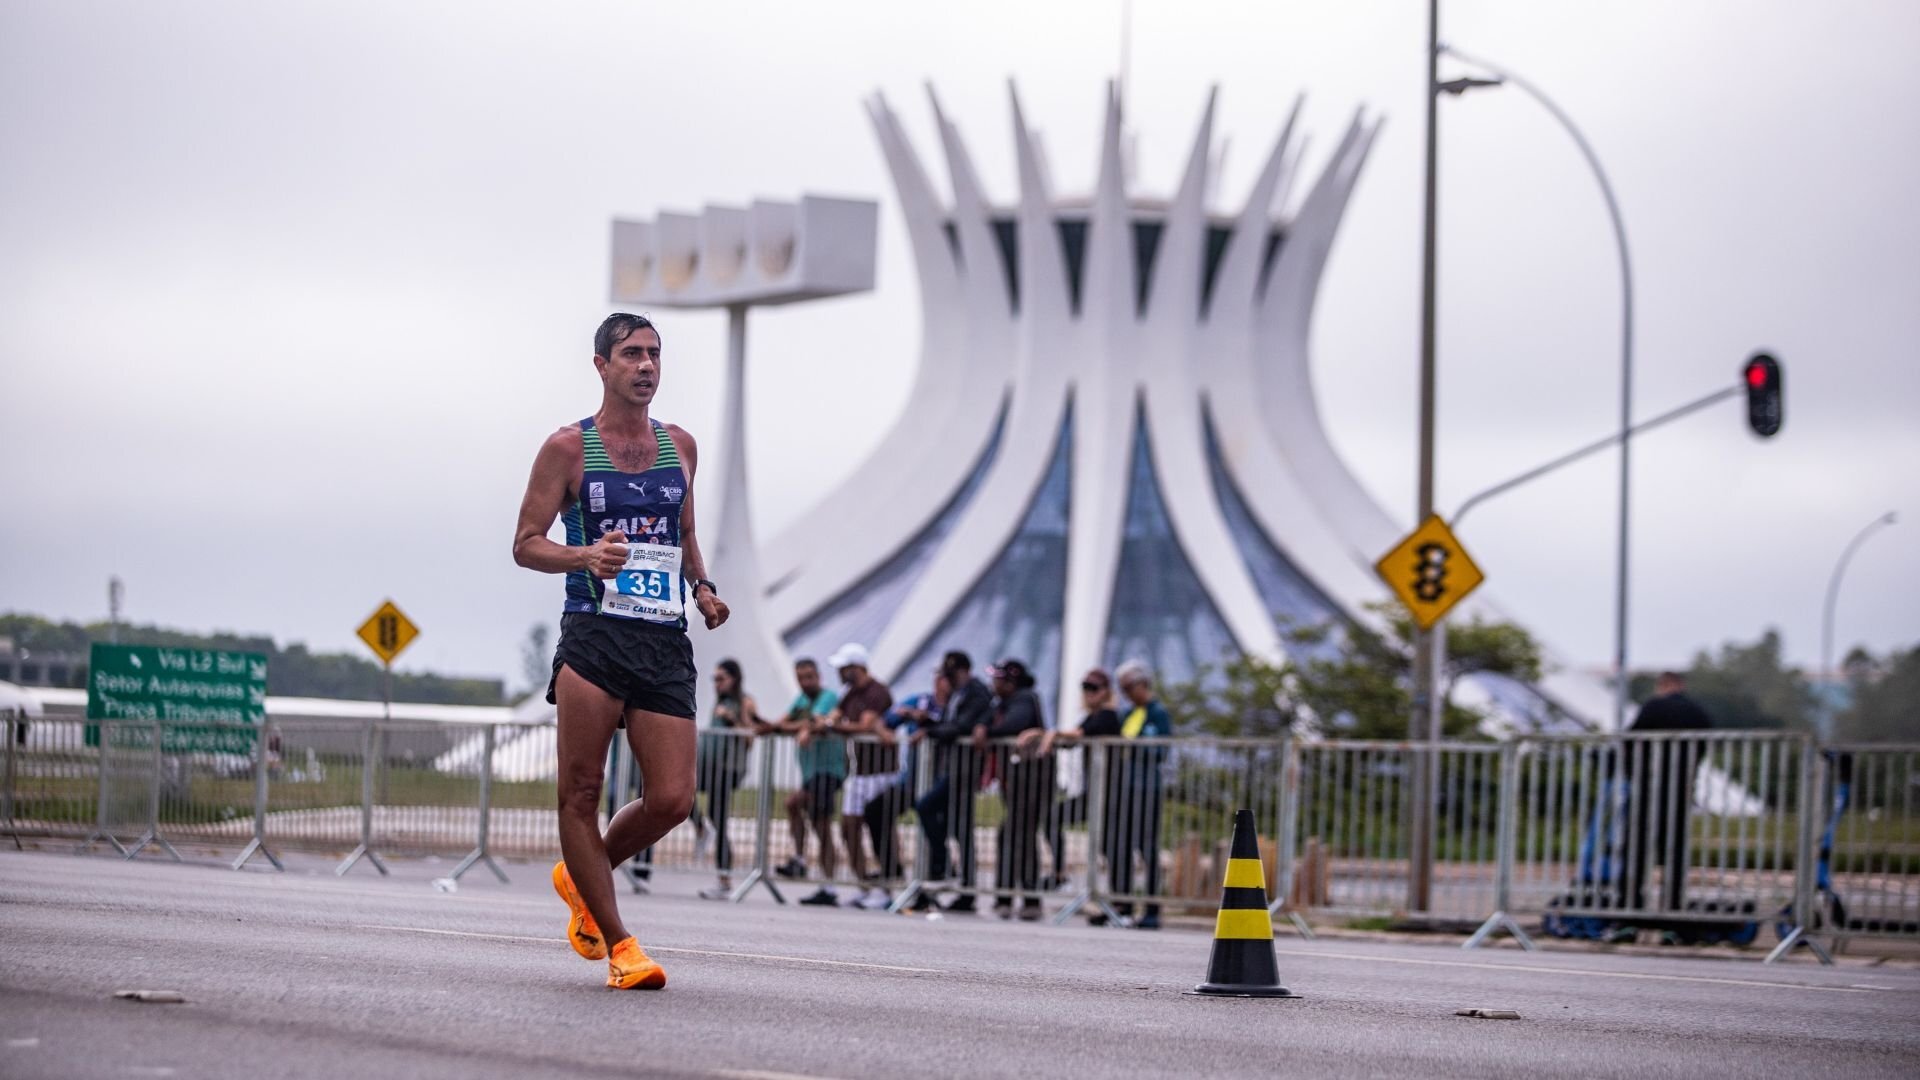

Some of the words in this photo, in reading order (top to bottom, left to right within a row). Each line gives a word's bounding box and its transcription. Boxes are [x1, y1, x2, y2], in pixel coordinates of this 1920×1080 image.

[599, 516, 668, 535] CAIXA
[633, 549, 676, 559] ATLETISMO
[633, 554, 660, 562] BRASIL
[628, 572, 662, 597] 35
[633, 605, 658, 615] CAIXA
[158, 648, 186, 669] Via
[190, 650, 213, 673] L2
[217, 652, 246, 674] Sul
[95, 670, 142, 692] Setor
[149, 675, 244, 701] Autarquias
[104, 700, 156, 721] Praça
[163, 700, 243, 723] Tribunais
